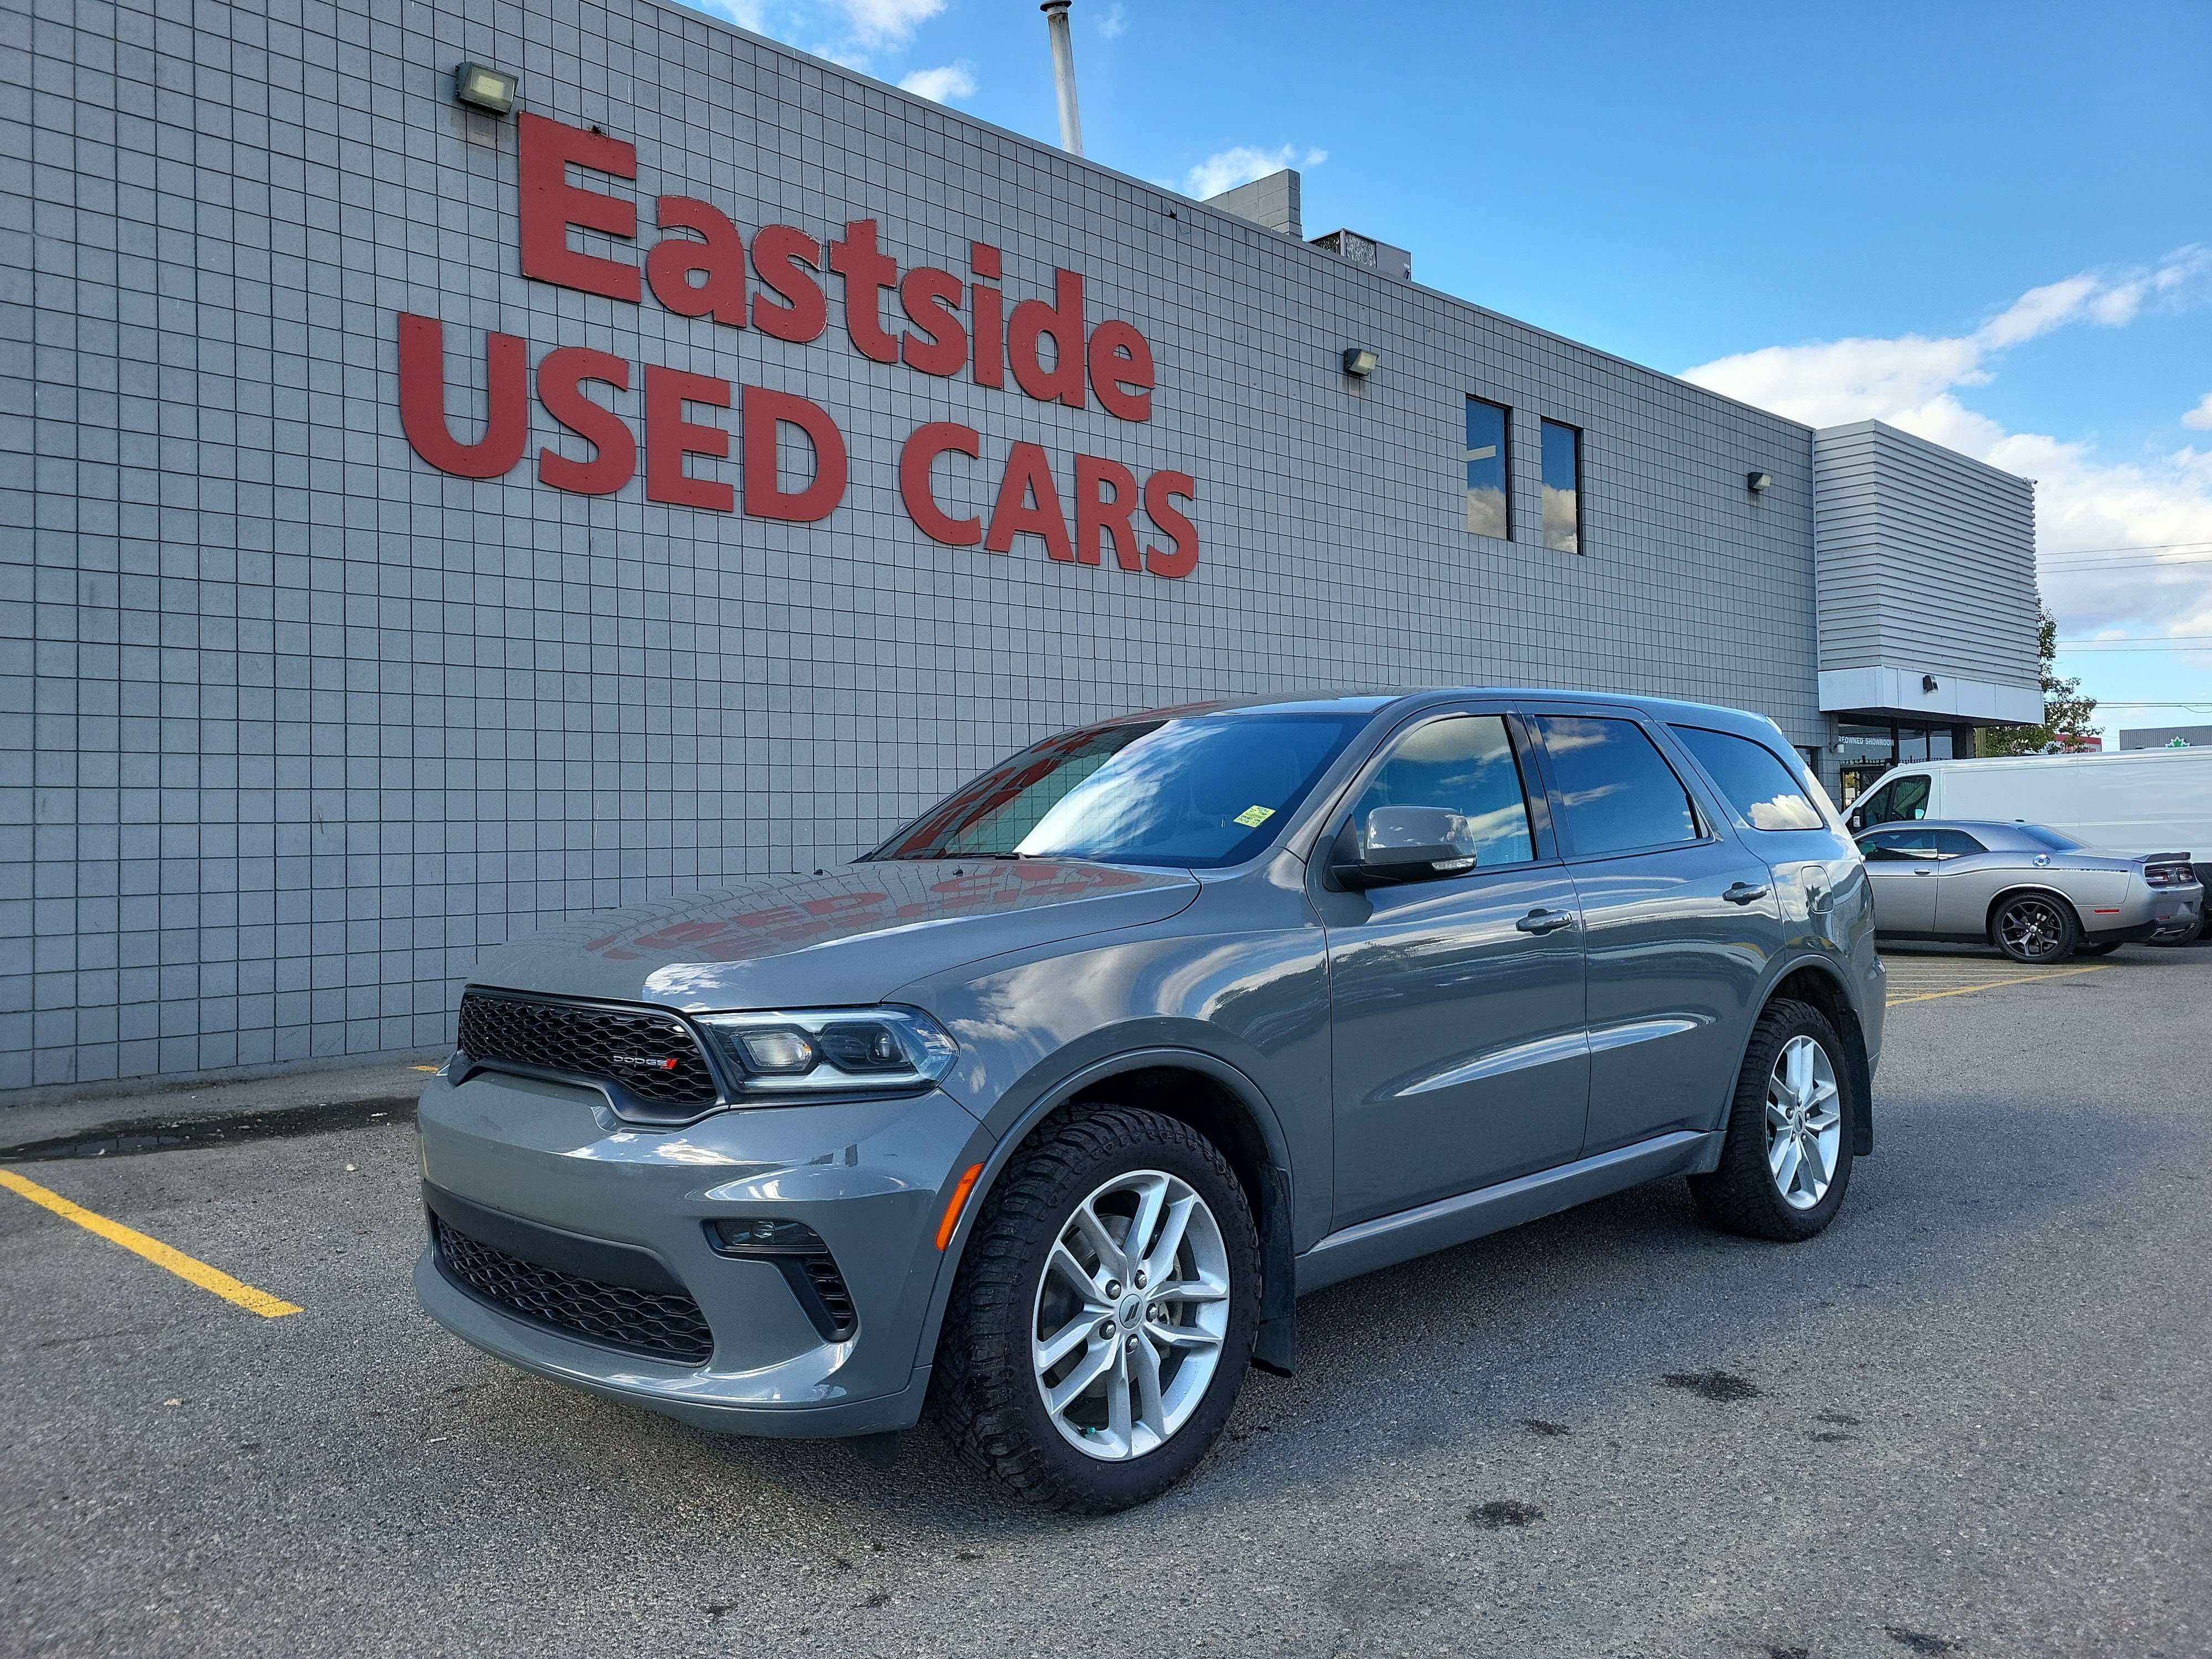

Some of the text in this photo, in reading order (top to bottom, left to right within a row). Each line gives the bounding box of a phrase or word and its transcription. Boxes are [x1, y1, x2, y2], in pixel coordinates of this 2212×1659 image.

[518, 112, 1155, 421] Eastside
[399, 313, 1198, 578] USED CARS
[1865, 738, 1895, 747] SHOWROOM
[613, 1055, 668, 1066] DODGE
